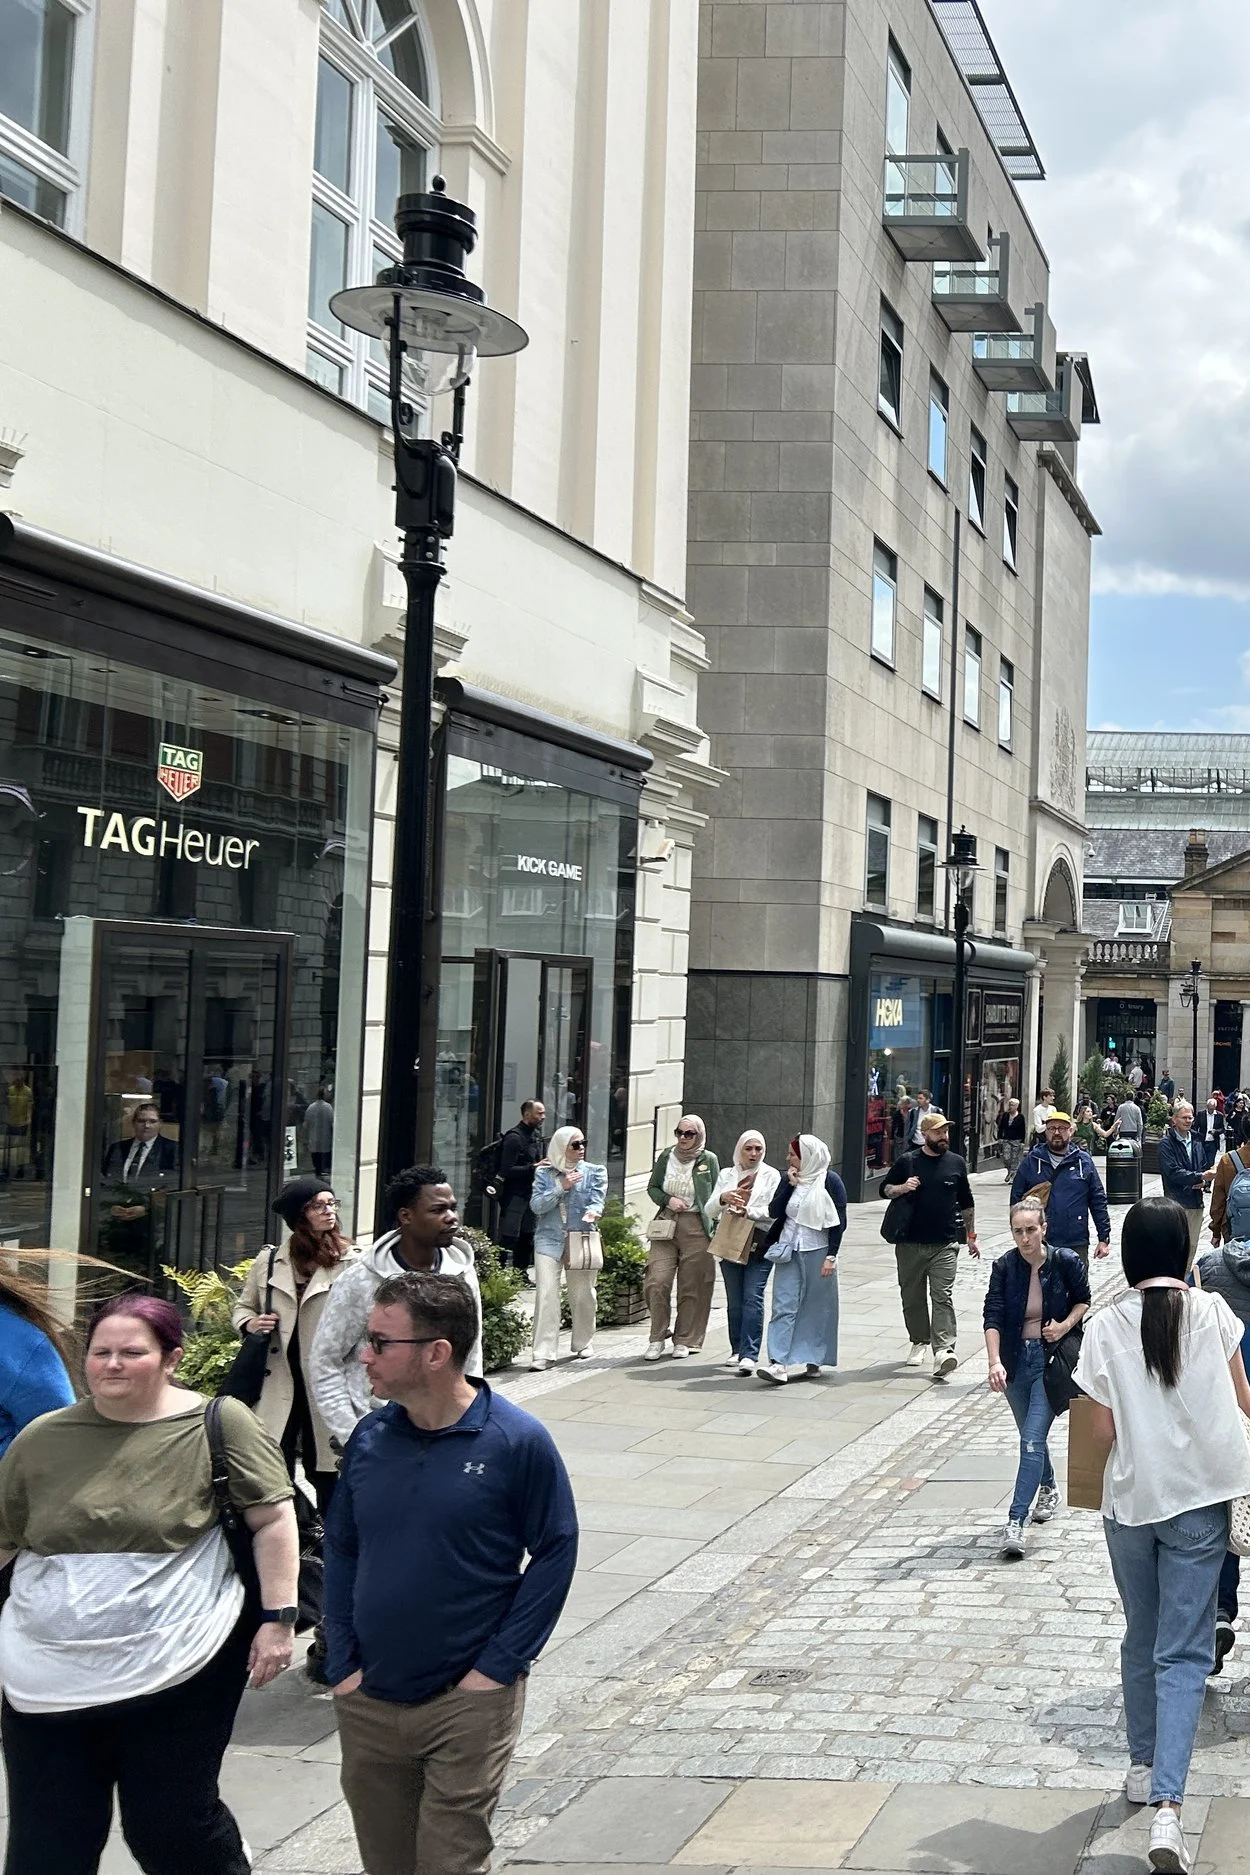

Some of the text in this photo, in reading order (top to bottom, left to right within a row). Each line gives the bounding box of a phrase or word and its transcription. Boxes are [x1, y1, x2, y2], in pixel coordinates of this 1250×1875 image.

[164, 747, 199, 769] TAG
[159, 767, 199, 796] HEUER
[517, 854, 582, 881] KICK GAME
[875, 999, 903, 1027] HOKA
